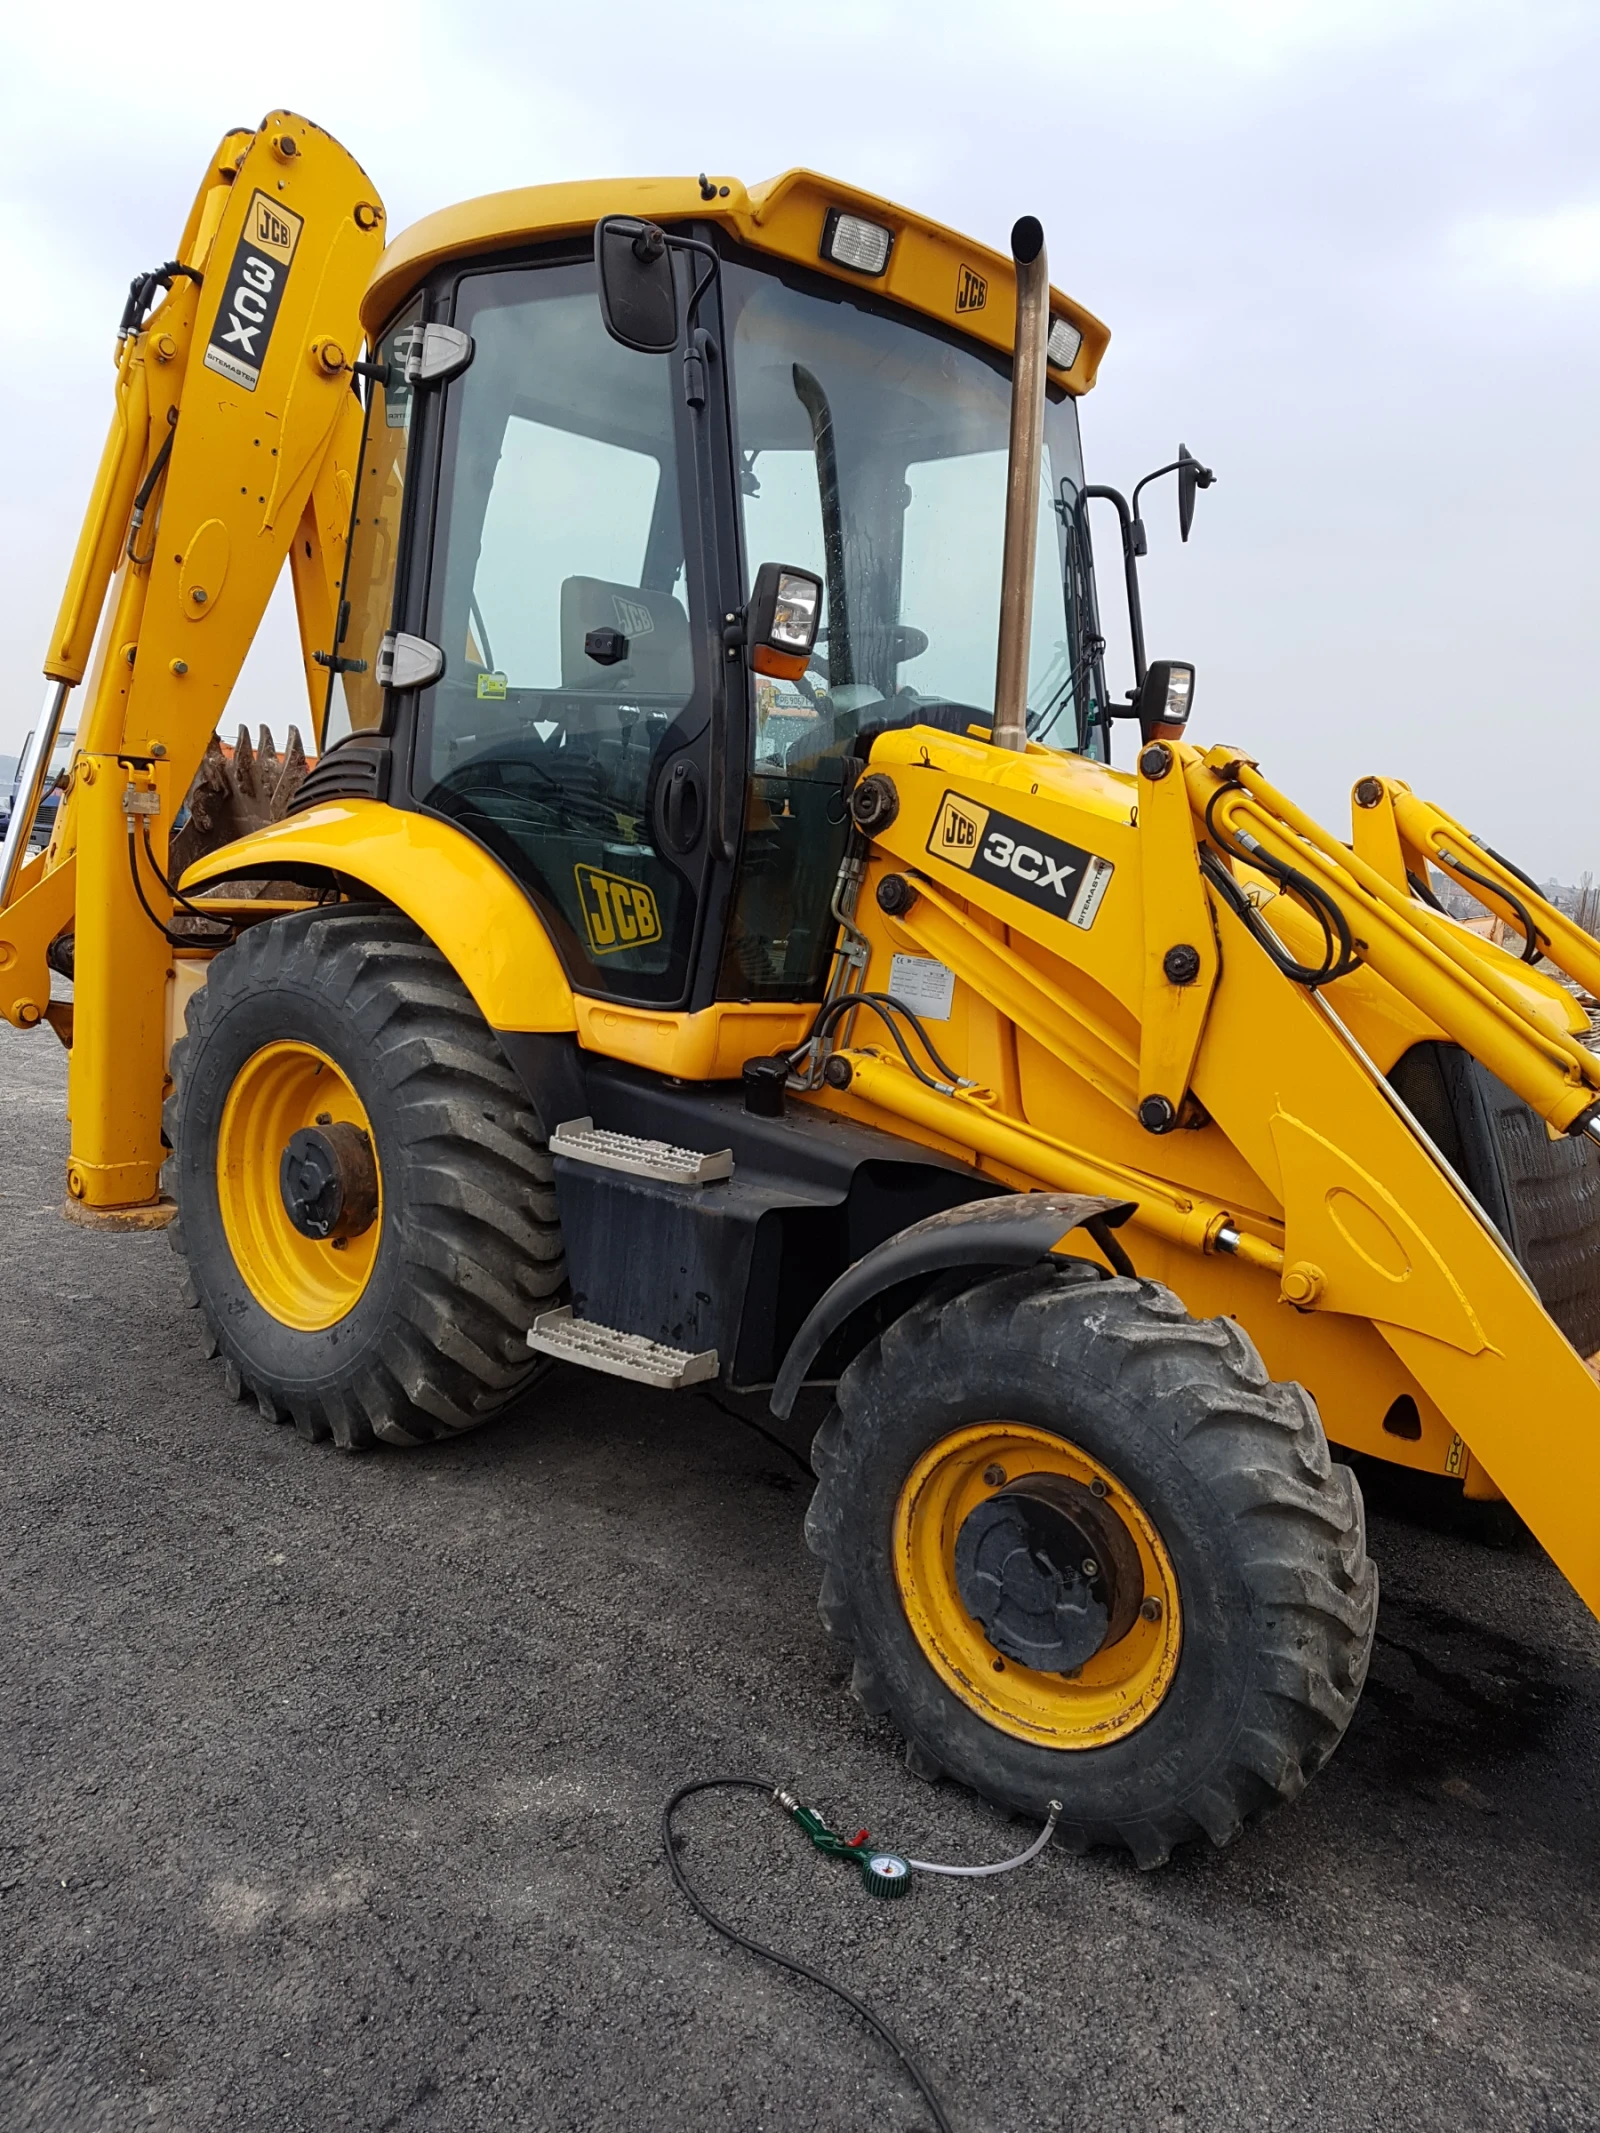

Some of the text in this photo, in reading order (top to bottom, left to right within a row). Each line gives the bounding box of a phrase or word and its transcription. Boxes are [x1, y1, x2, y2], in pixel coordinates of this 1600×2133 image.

[260, 209, 289, 246] JCB
[220, 256, 276, 357] 3CX
[958, 270, 986, 309] JCB
[207, 353, 256, 385] SITEMASTER
[618, 599, 652, 635] JCB
[945, 810, 975, 846] JCB
[983, 832, 1076, 898] 3CX
[590, 875, 656, 945] JCB
[1077, 861, 1106, 926] SITEMASTER
